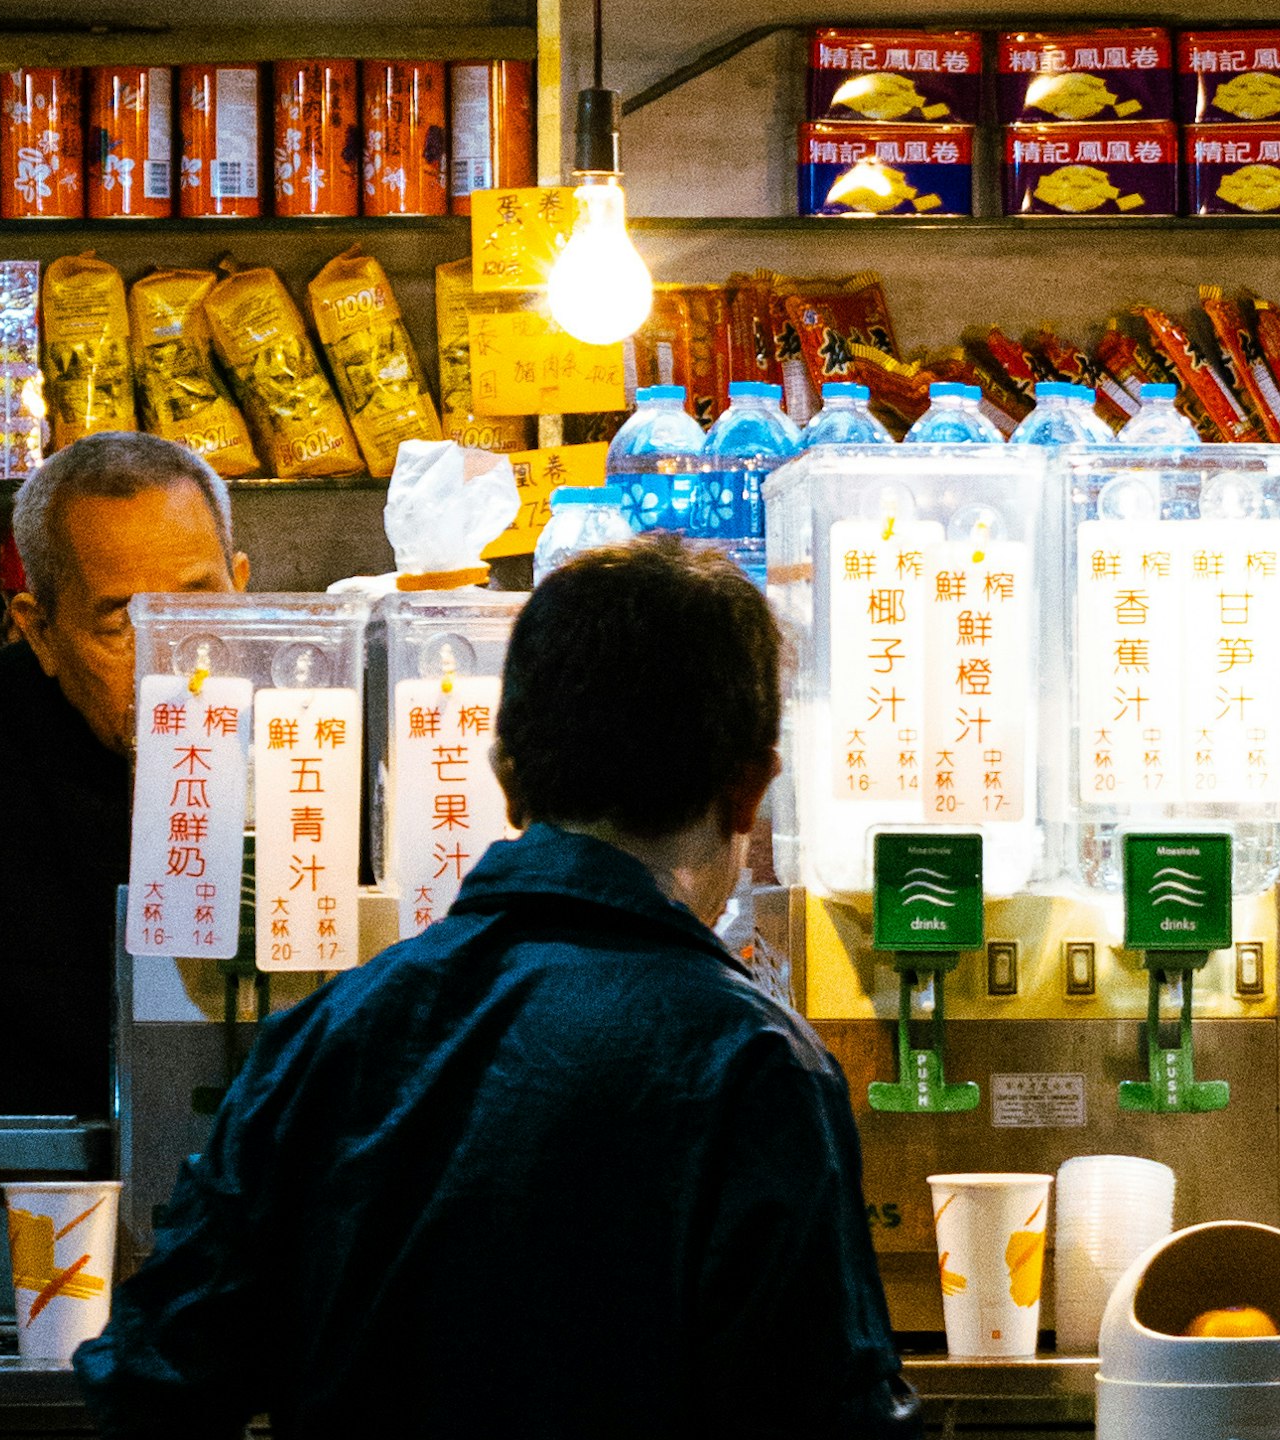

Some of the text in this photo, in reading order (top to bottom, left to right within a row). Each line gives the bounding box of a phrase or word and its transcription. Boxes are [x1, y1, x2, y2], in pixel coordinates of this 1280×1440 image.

[842, 549, 925, 582] 鮮榨
[1089, 549, 1172, 582] 鮮榨
[1190, 549, 1278, 582] 鮮榨
[933, 570, 1016, 604] 鮮榨
[865, 586, 907, 724] 椰子汁
[1112, 588, 1151, 724] 香蕉汁
[955, 610, 994, 746] 鮮橙汁
[150, 703, 239, 736] 鮮榨
[266, 717, 348, 751] 鮮榨
[407, 704, 492, 738] 鮮榨
[846, 728, 918, 770] 大杯 中杯
[1092, 726, 1165, 769] 大杯 中杯
[1194, 726, 1268, 769] 大杯 中杯
[933, 749, 1004, 790] 大杯 中杯
[164, 745, 213, 879] 木瓜鮮奶
[289, 757, 326, 893] 五青汁
[431, 745, 471, 881] 芒果汁
[142, 882, 217, 924] 大杯 中杯
[270, 895, 337, 938] 大杯 中杯
[910, 917, 948, 931] drinks
[1160, 917, 1198, 931] drinks
[917, 1053, 928, 1108] PUSH
[1166, 1053, 1178, 1105] PUSH
